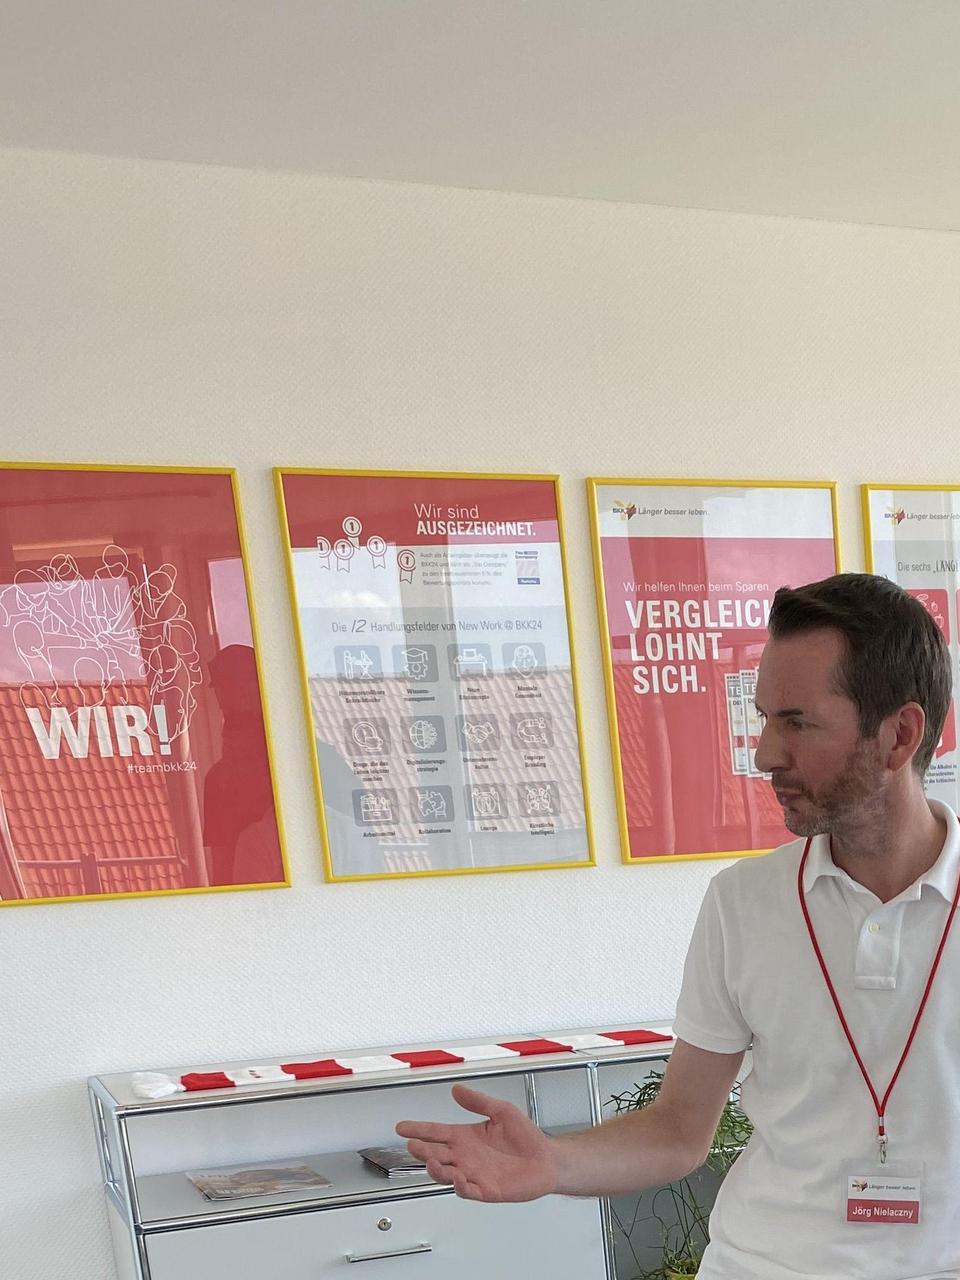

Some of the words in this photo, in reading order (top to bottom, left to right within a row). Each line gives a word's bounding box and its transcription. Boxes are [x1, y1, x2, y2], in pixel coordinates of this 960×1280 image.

[414, 504, 441, 518] Wir
[447, 505, 479, 519] sind
[416, 521, 536, 536] AUSGEZEICHNET.
[897, 562, 911, 571] Die
[911, 561, 931, 572] sechs
[623, 582, 641, 592] Wir
[644, 582, 675, 592] helfen
[678, 583, 705, 592] Ihnen
[708, 582, 733, 592] beim
[332, 623, 347, 633] Die
[370, 622, 440, 634] Handlungsfelder
[441, 624, 457, 632] von
[459, 621, 478, 631] New
[480, 621, 502, 631] Work
[515, 620, 542, 630] BKK24
[629, 632, 722, 661] LOHNT
[633, 665, 707, 694] SICH.
[26, 704, 172, 760] WIR!
[127, 760, 198, 774] #teambkk24
[852, 1206, 872, 1218] Jörg
[873, 1207, 914, 1219] Nielaczny
